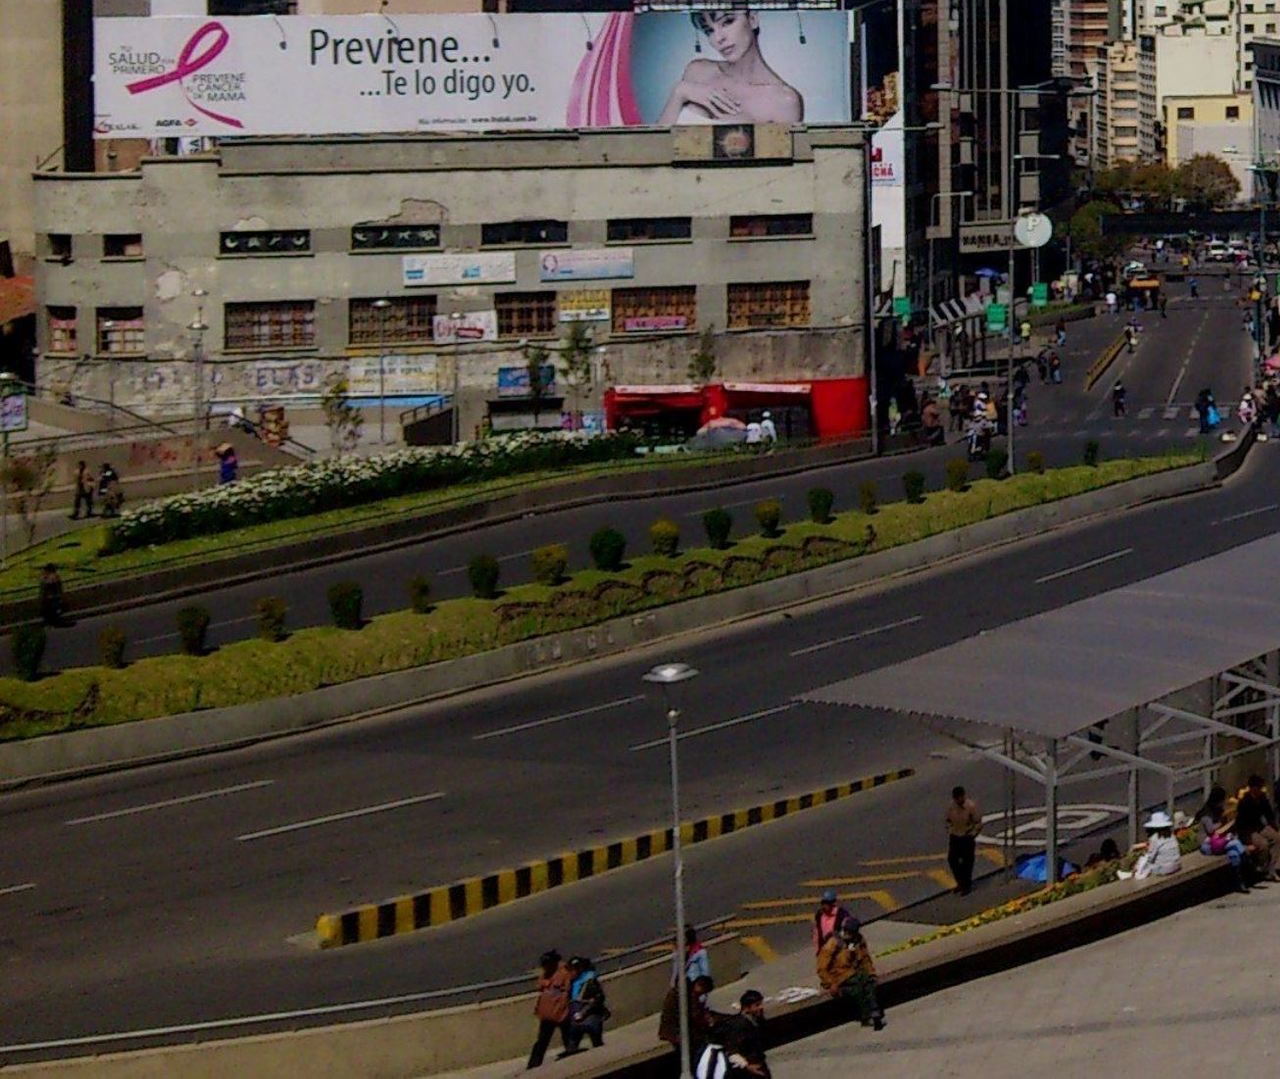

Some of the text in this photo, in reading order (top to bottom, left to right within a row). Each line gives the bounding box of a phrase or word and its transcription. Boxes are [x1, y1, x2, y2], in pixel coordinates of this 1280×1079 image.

[310, 28, 490, 66] Previene...
[109, 52, 160, 66] SALUD
[113, 65, 165, 75] PRIMERO
[193, 73, 246, 84] PREVIENE
[360, 68, 536, 101] ...Te lo digo yo.
